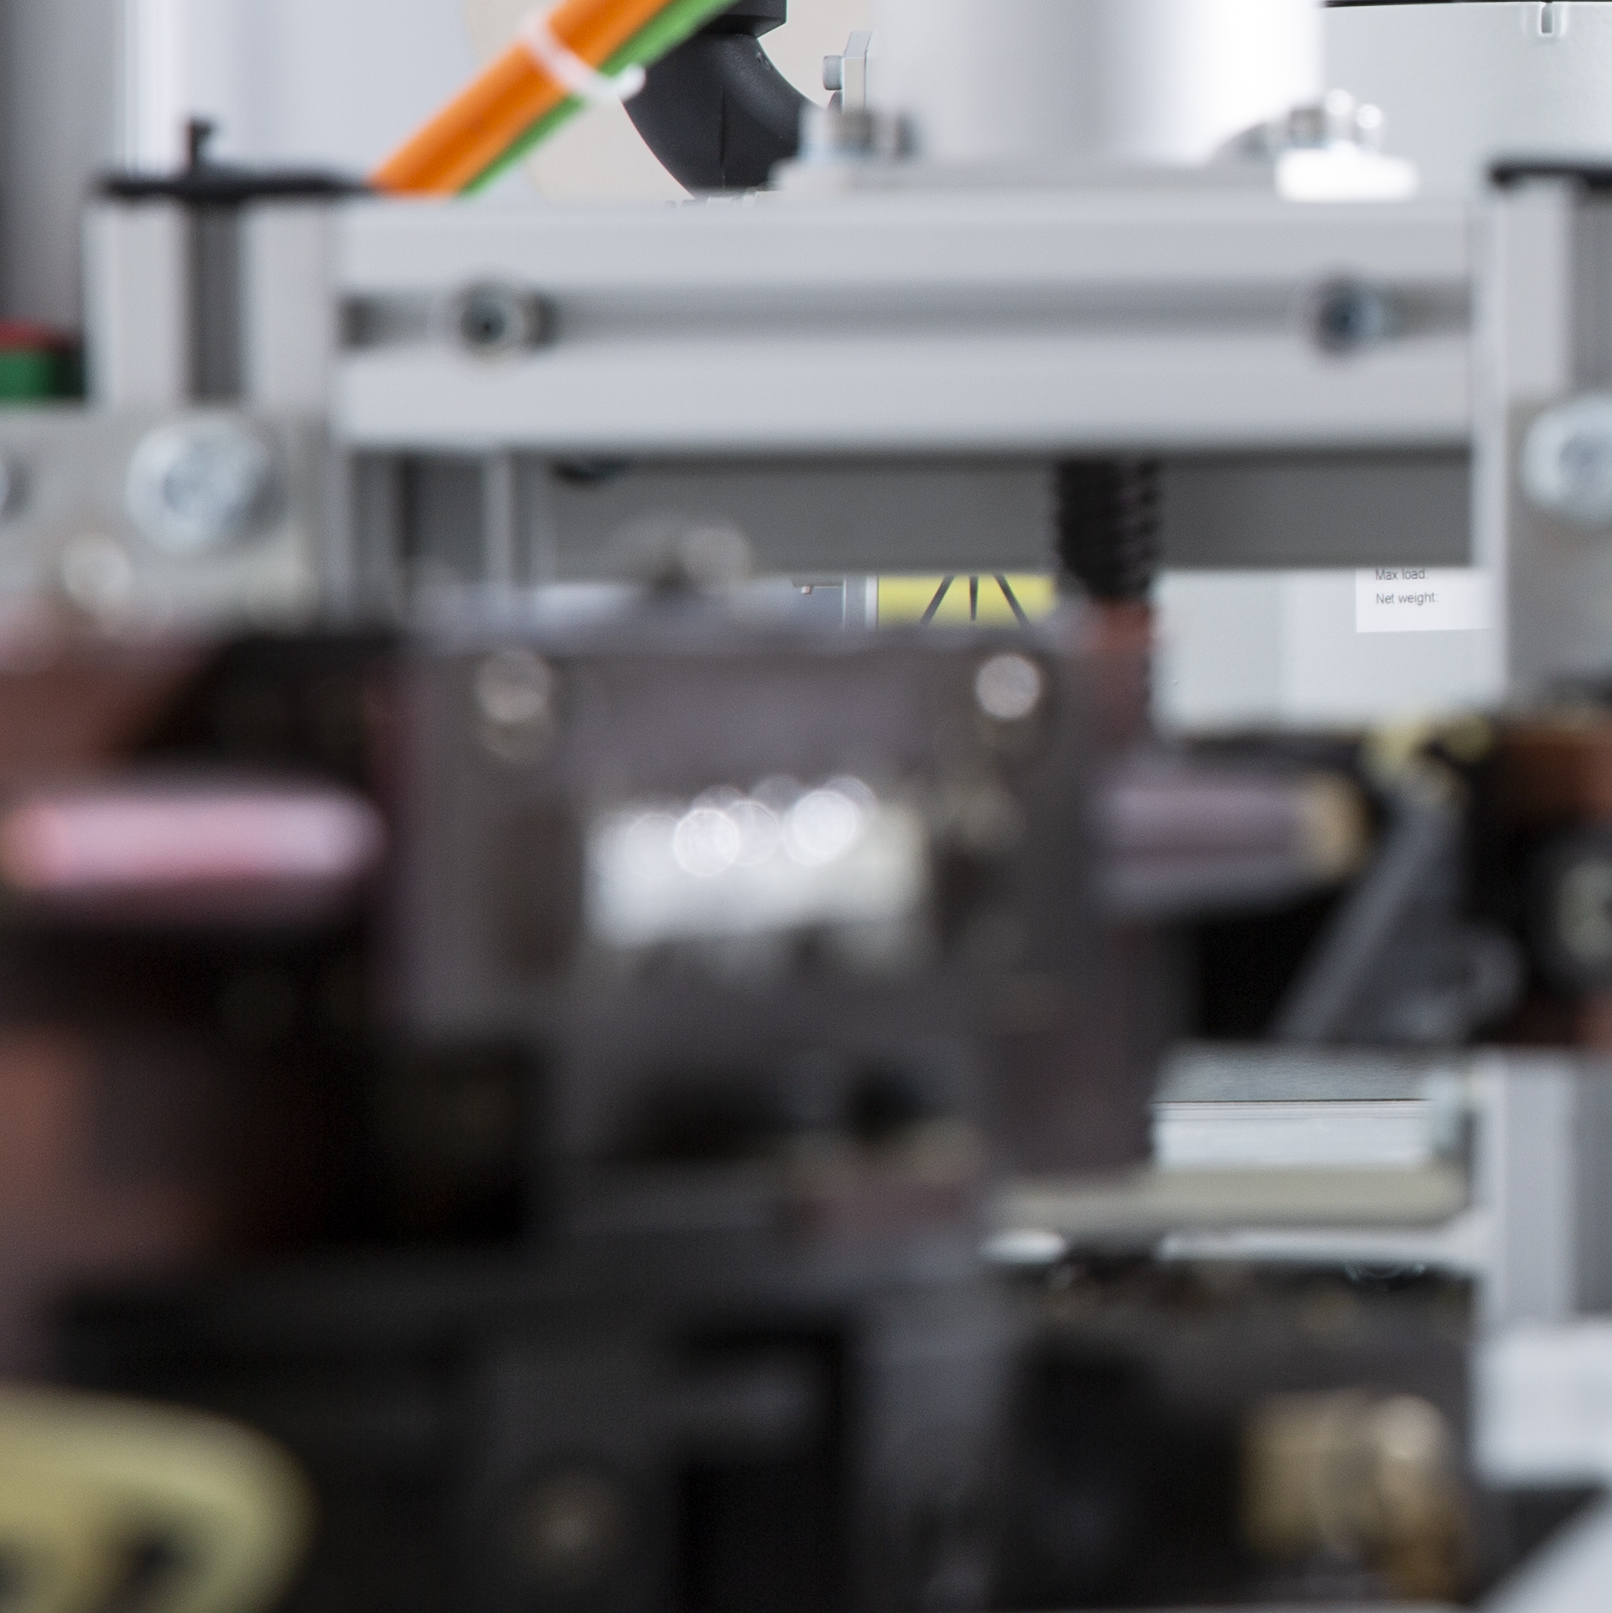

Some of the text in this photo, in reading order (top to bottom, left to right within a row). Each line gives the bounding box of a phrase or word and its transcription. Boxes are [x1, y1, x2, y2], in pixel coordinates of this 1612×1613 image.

[1375, 568, 1399, 581] Max
[1375, 591, 1439, 606] Net weight:
